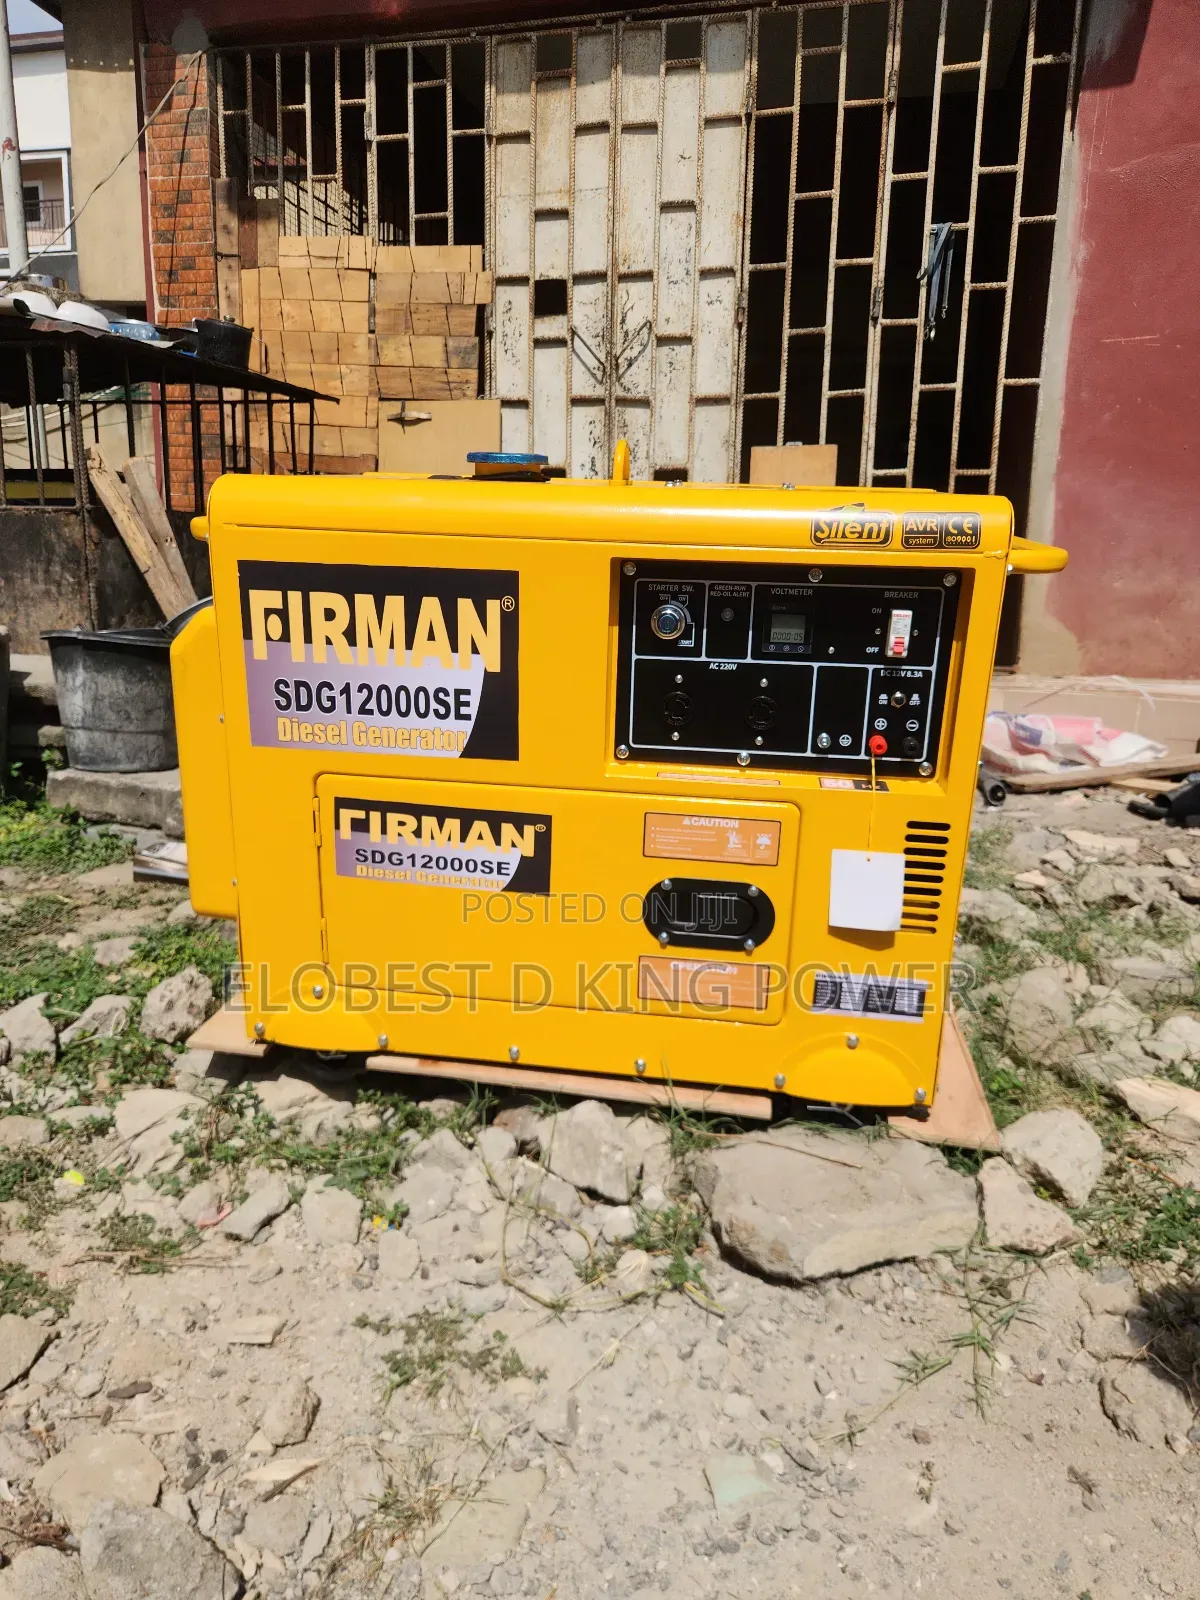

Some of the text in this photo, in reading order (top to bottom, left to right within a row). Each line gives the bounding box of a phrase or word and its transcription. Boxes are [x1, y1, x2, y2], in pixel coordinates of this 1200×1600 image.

[815, 515, 890, 540] Silent
[906, 517, 938, 531] AVR
[908, 537, 934, 546] system
[770, 588, 813, 596] VOLTMETER
[880, 669, 891, 677] DC
[273, 678, 472, 721] SDG12000SE
[276, 717, 468, 752] Diesel Generator
[691, 817, 739, 829] CAUTION
[355, 848, 511, 876] SDG12000SE
[356, 864, 506, 889] Diesel Generator
